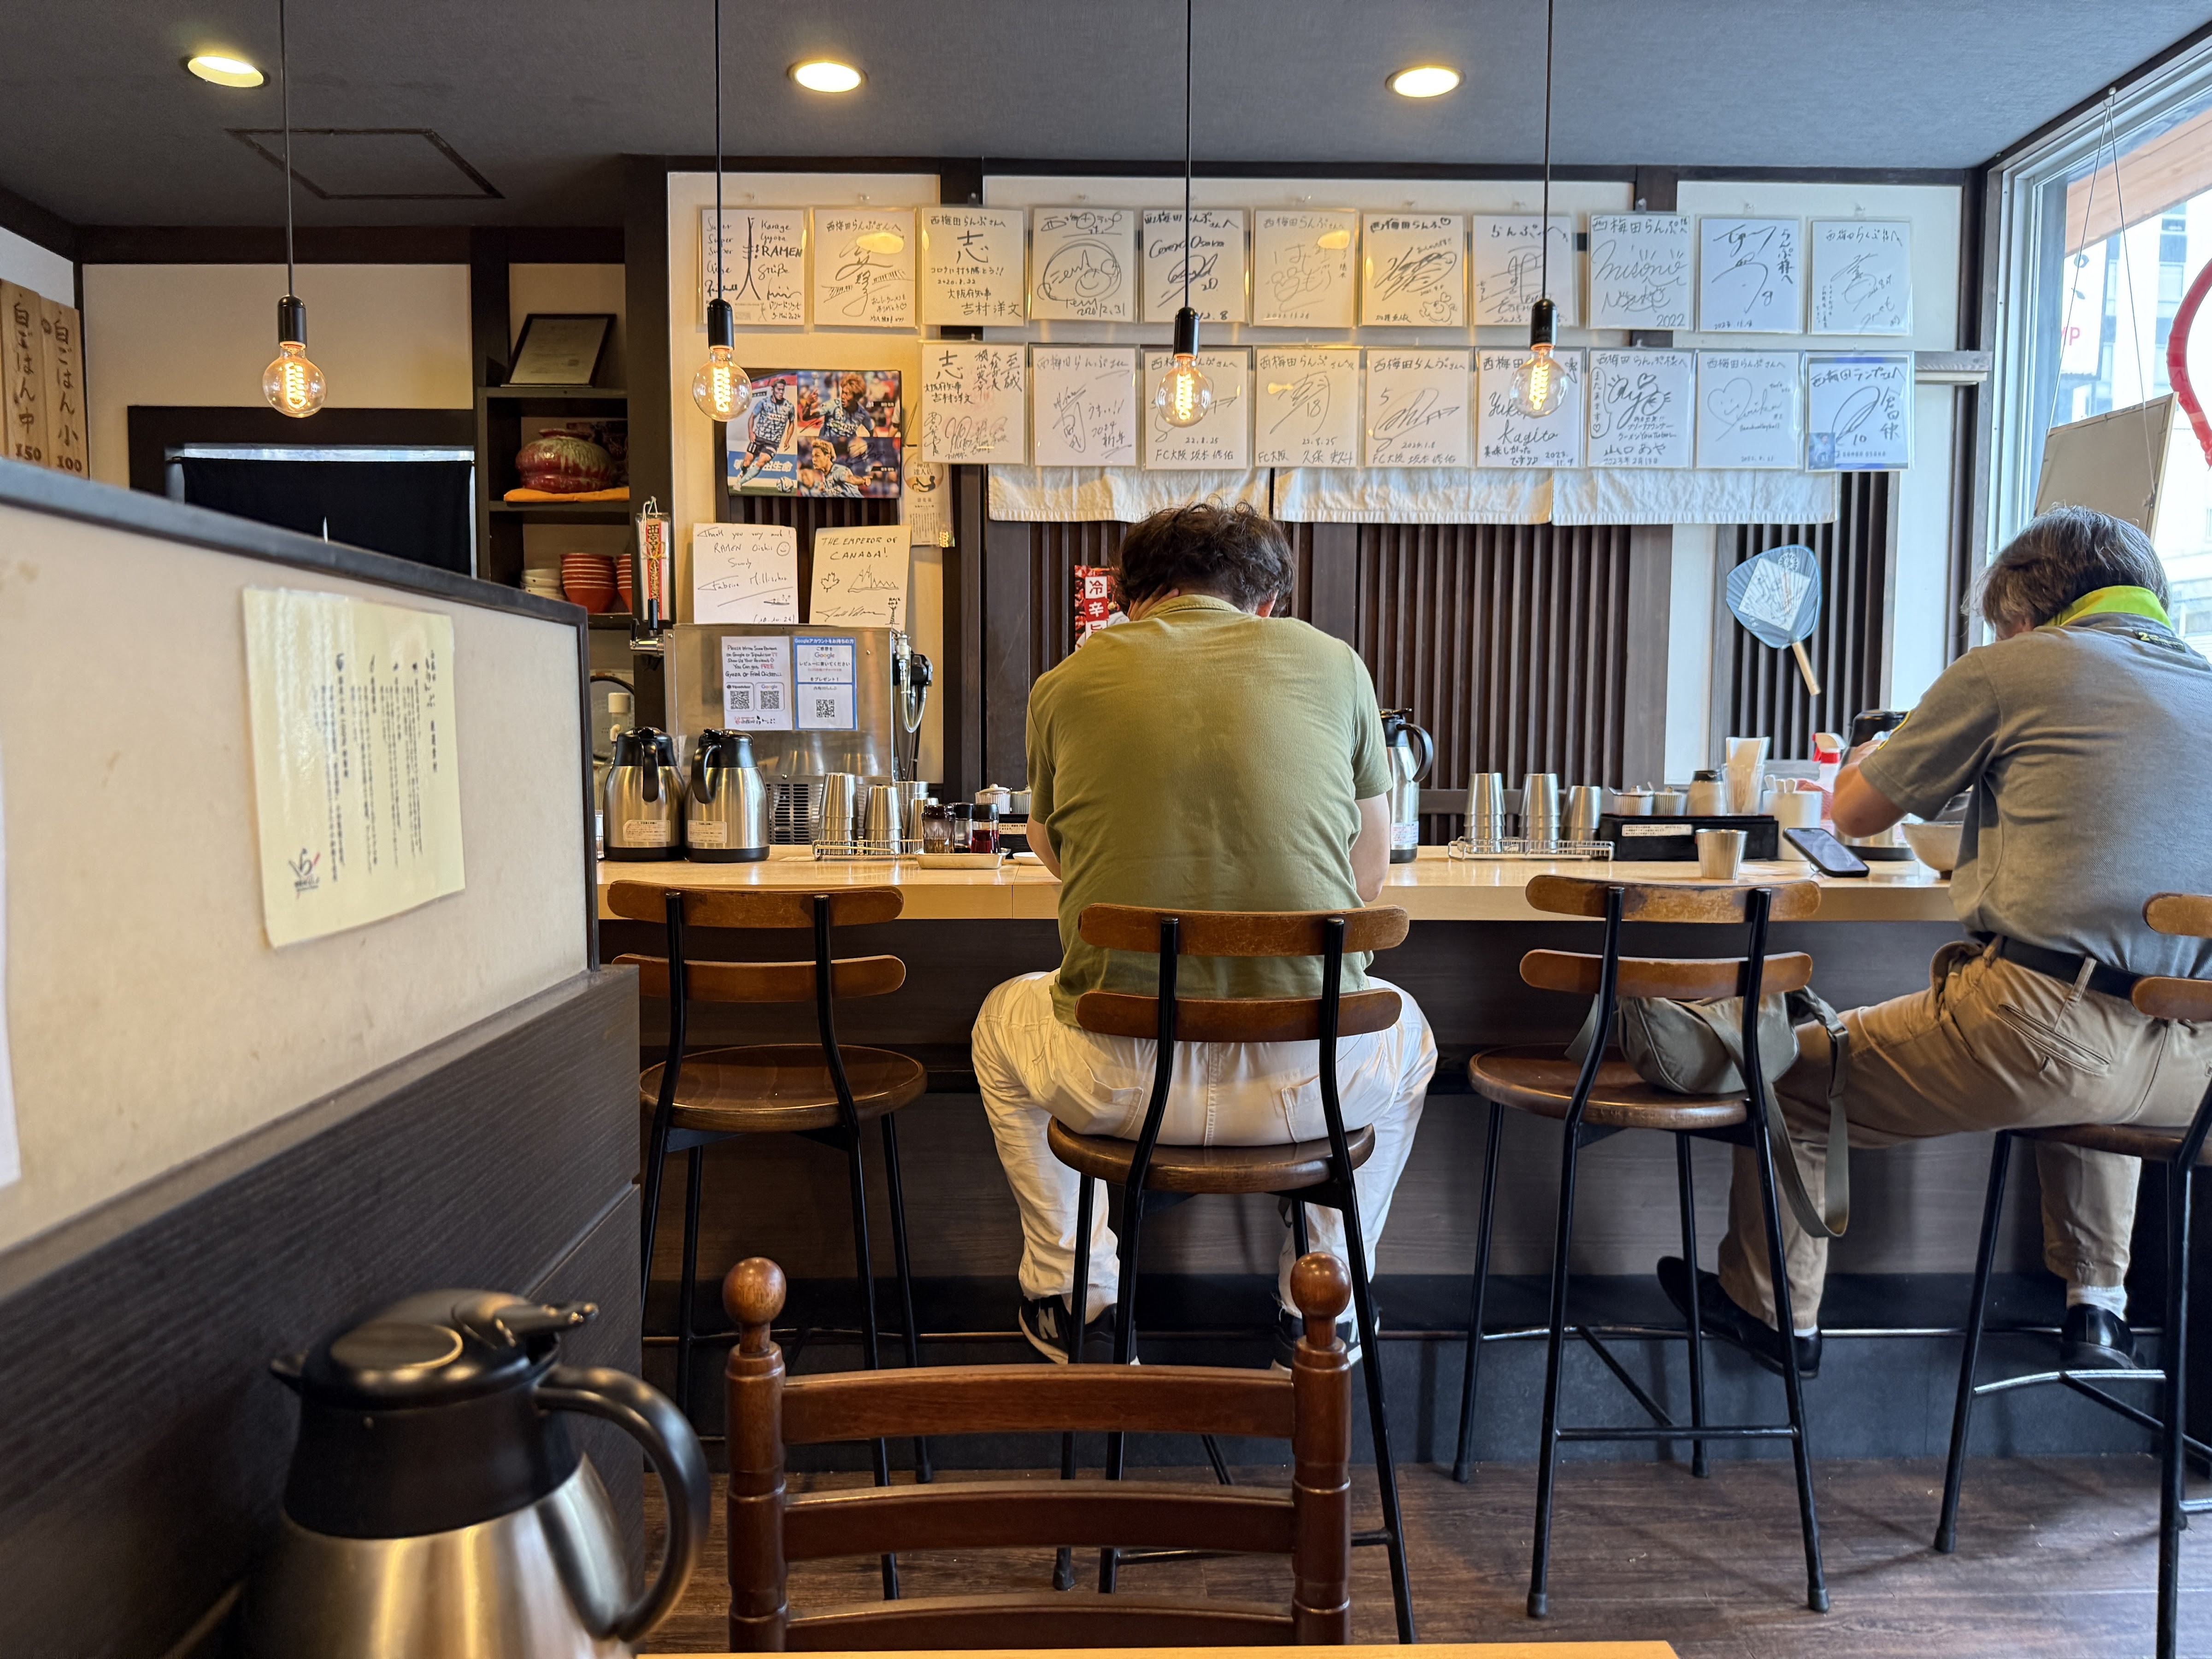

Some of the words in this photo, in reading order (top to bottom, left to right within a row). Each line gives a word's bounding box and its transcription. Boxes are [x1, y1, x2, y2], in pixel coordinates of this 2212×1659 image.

[761, 246, 802, 258] RAMEN
[956, 230, 989, 264] 志
[961, 300, 1022, 318] 吉村洋文
[1656, 313, 1685, 327] 2022
[939, 350, 963, 380] 志
[16, 443, 41, 461] 150
[57, 455, 82, 471] 100
[714, 542, 741, 553] RAMEN
